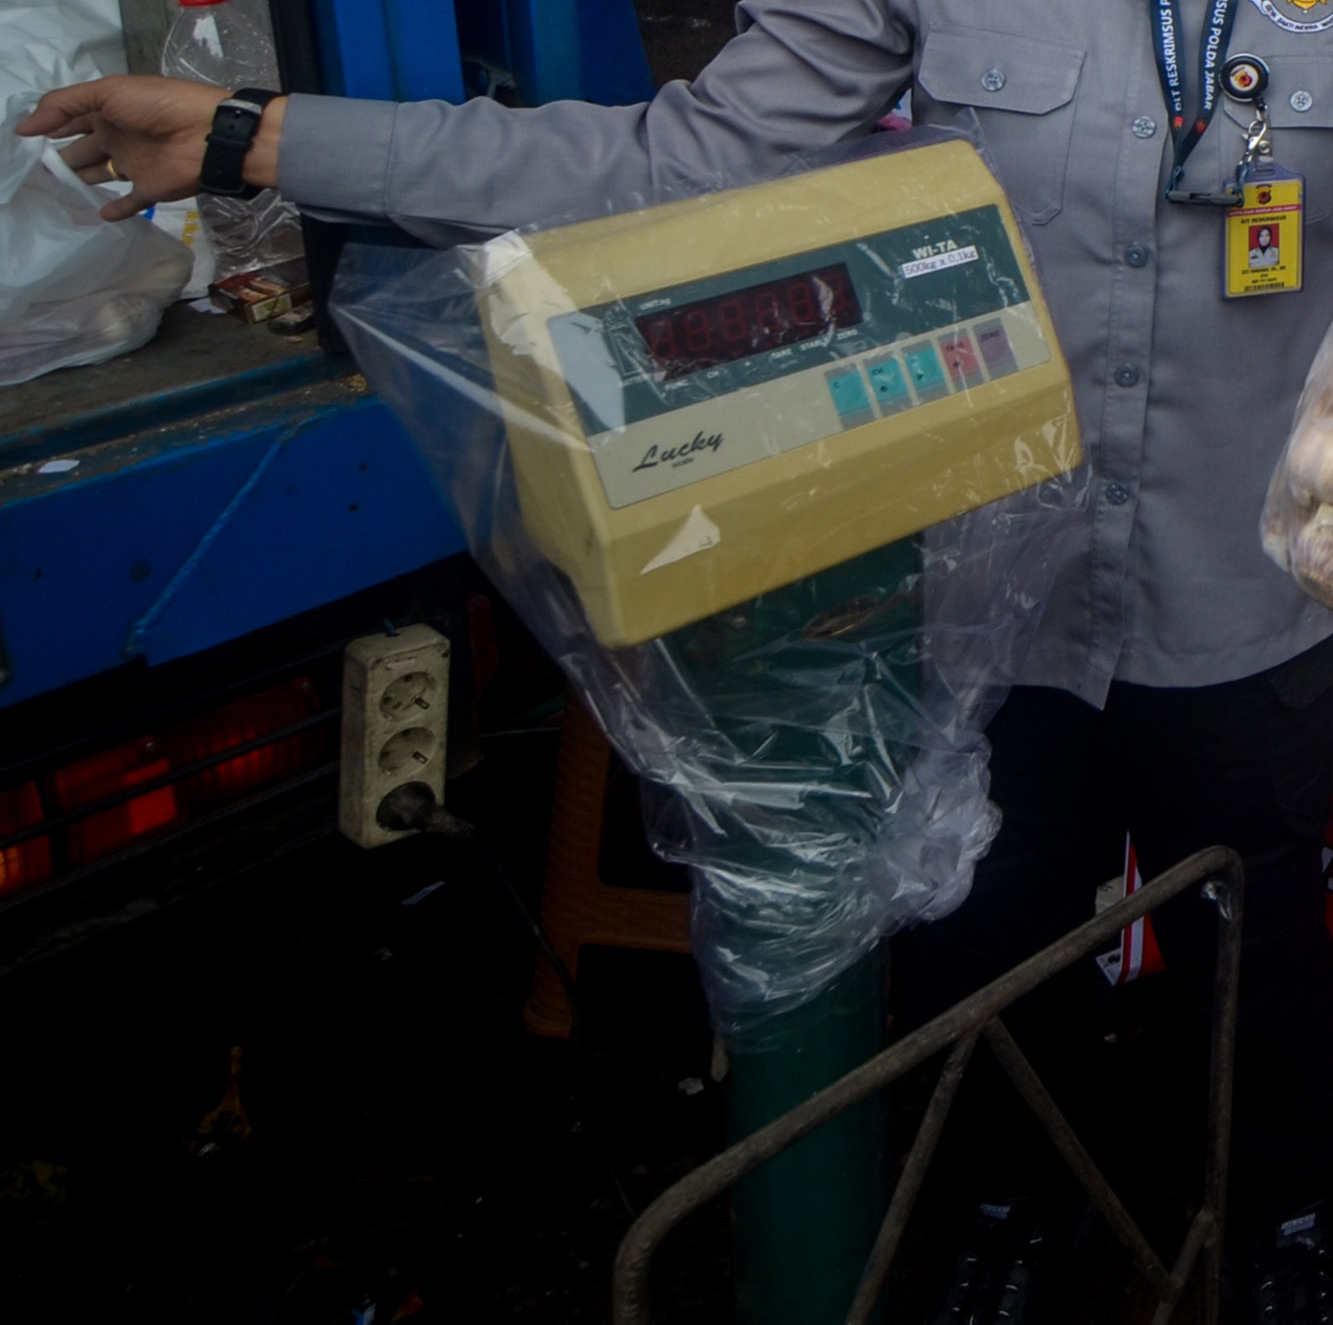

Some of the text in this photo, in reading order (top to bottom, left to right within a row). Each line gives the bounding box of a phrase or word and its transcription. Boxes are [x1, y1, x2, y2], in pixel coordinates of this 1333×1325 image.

[1160, 7, 1180, 87] RESKRIMSUS
[1205, 26, 1222, 68] POLDA
[631, 431, 724, 473] Lucky
